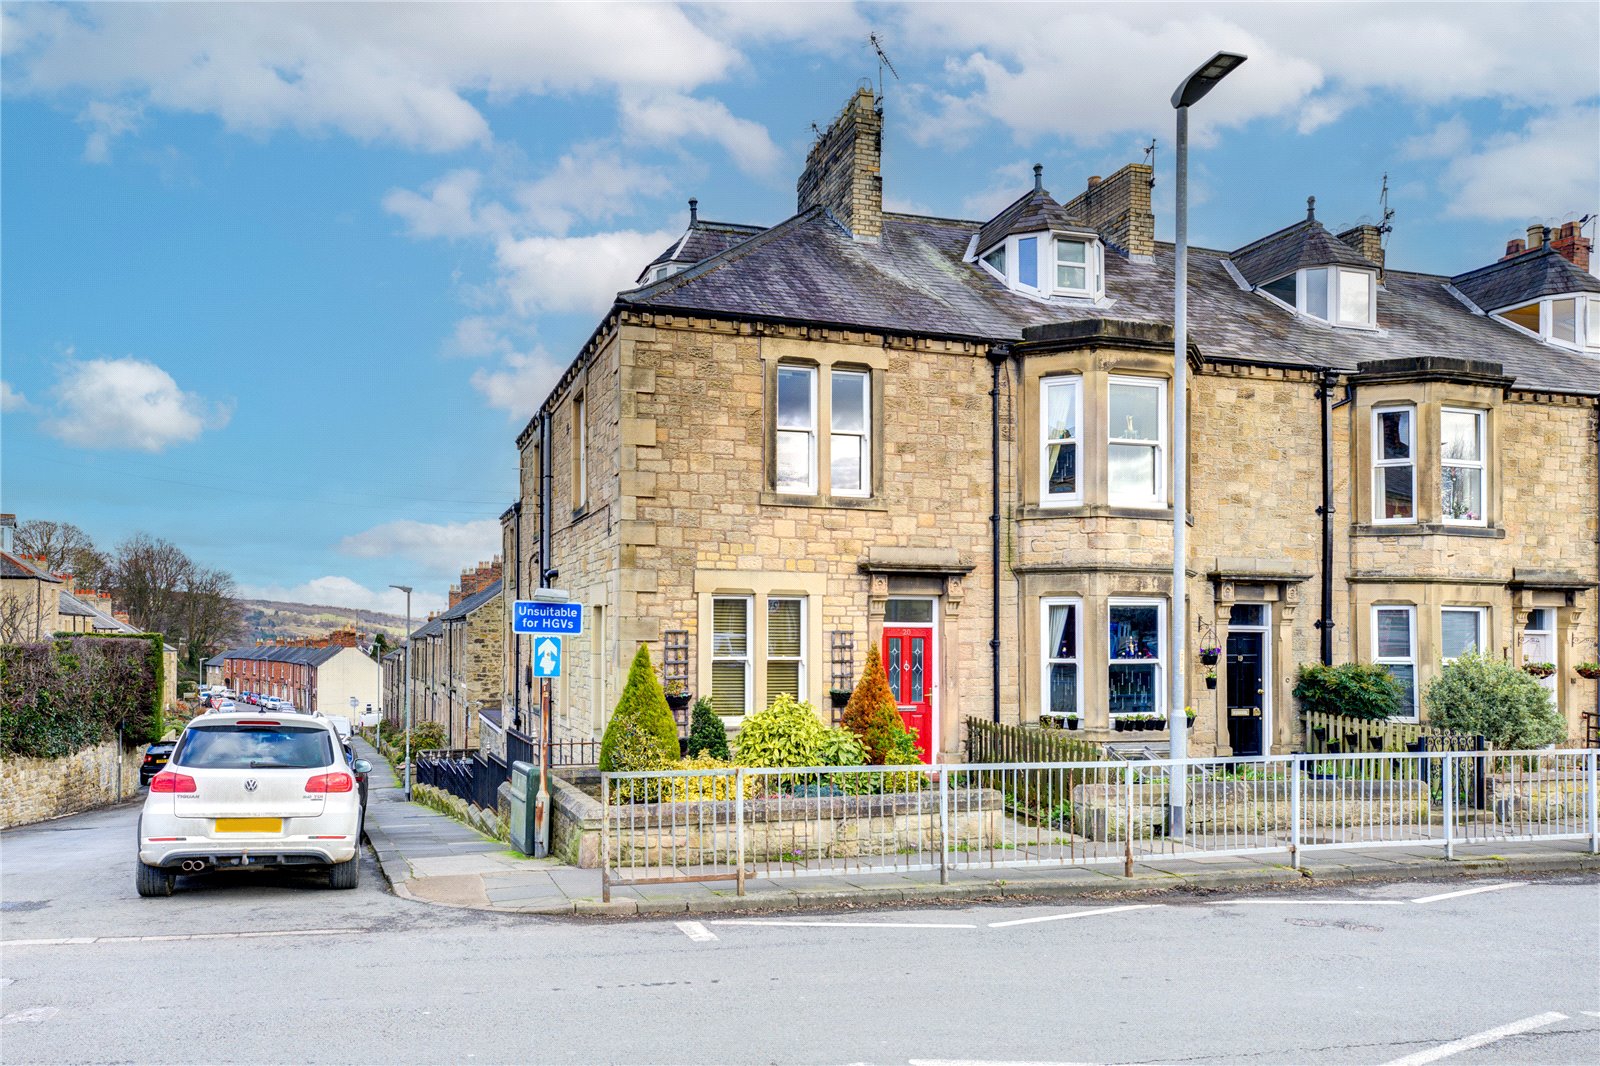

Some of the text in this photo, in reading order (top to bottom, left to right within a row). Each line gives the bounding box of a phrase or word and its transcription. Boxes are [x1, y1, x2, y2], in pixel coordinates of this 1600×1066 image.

[519, 606, 577, 617] Unsuitable
[522, 618, 573, 628] for HGVs
